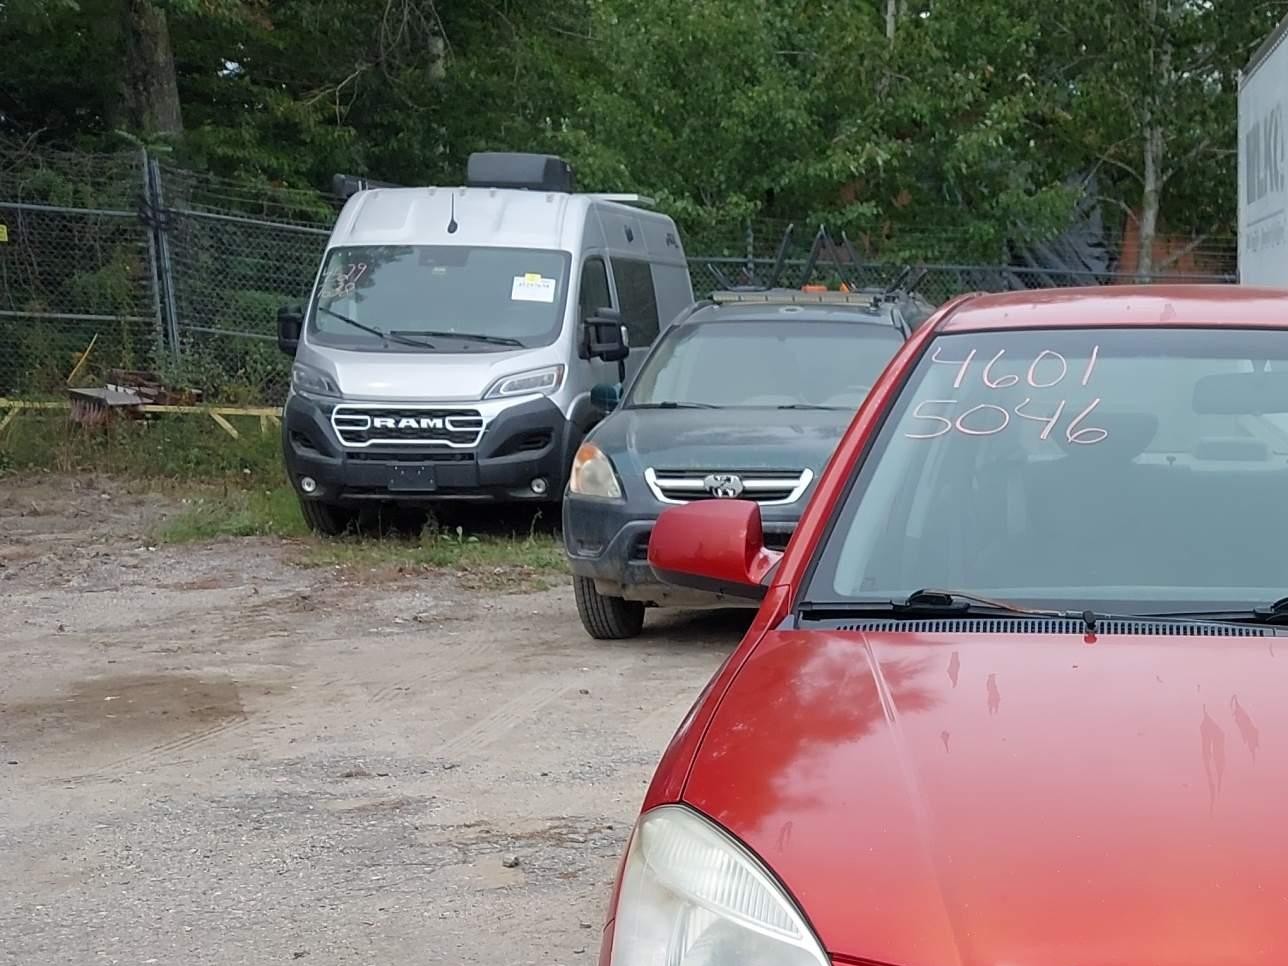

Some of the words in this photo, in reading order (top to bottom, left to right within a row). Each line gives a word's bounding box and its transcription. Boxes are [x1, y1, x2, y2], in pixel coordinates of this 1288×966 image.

[931, 345, 1099, 388] 4601
[373, 417, 443, 429] RAM
[904, 398, 1108, 444] 5046
